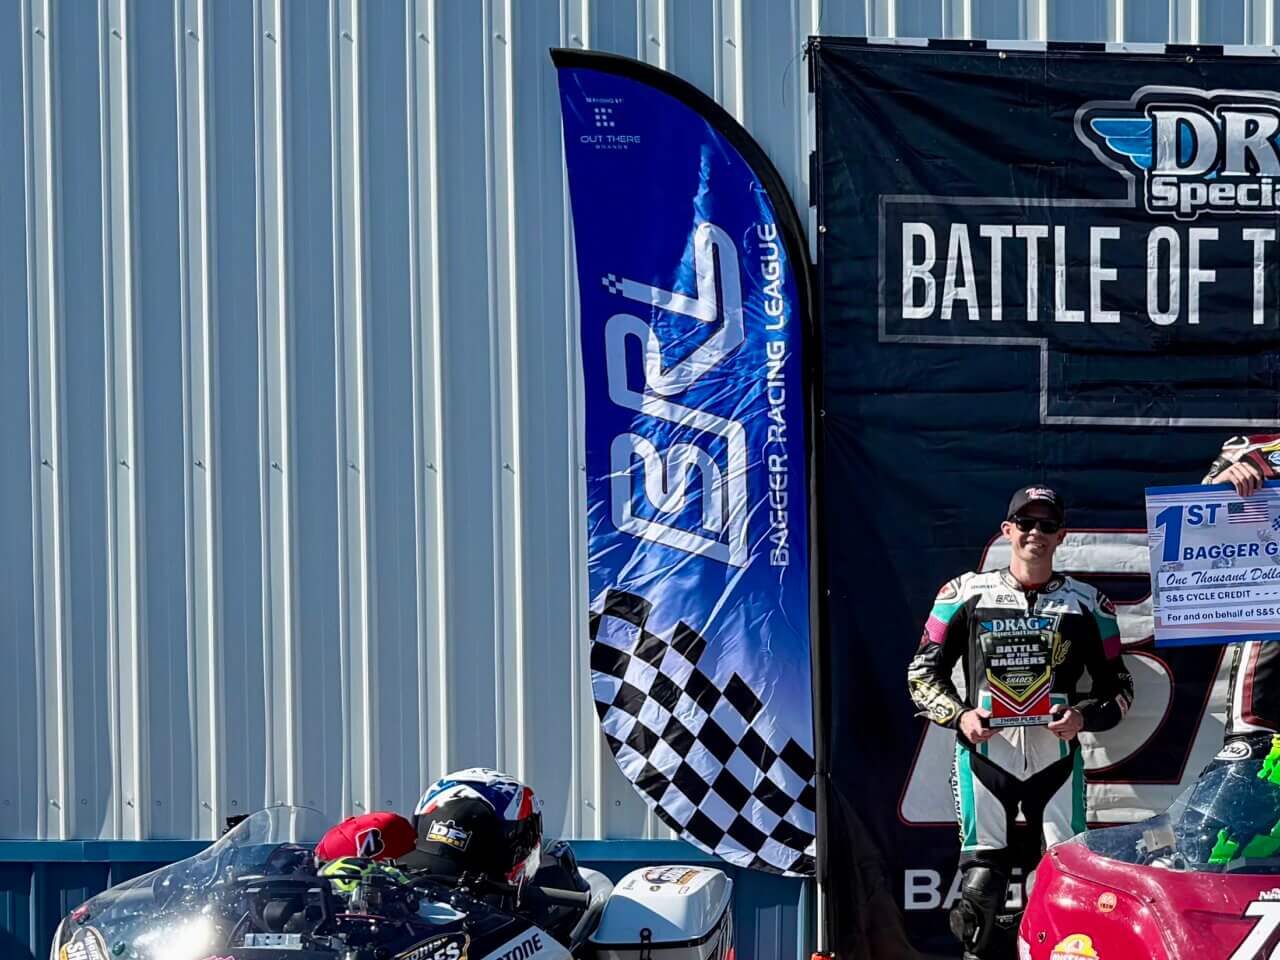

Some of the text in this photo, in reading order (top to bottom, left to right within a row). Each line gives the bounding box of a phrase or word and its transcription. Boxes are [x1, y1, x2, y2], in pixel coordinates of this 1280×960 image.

[901, 222, 1121, 325] BATTLE
[1146, 225, 1220, 326] OF
[603, 221, 749, 569] BRL
[756, 222, 790, 567] BAGGER RACING LEAGUE
[1154, 502, 1222, 562] 1ST
[1183, 543, 1259, 562] BAGGER
[1166, 573, 1188, 586] One
[1193, 569, 1247, 584] Thousand
[1166, 593, 1186, 603] S&S
[1187, 591, 1215, 602] CYCLE
[1218, 589, 1251, 600] CREDIT
[1167, 613, 1182, 622] For
[1183, 612, 1200, 622] and
[1202, 612, 1214, 620] on
[1215, 608, 1243, 619] behalf
[1245, 607, 1255, 617] of
[1256, 606, 1275, 617] S&S
[991, 618, 1040, 632] DRAG
[995, 644, 1040, 654] BATTLE
[990, 656, 1046, 667] BAGGERS
